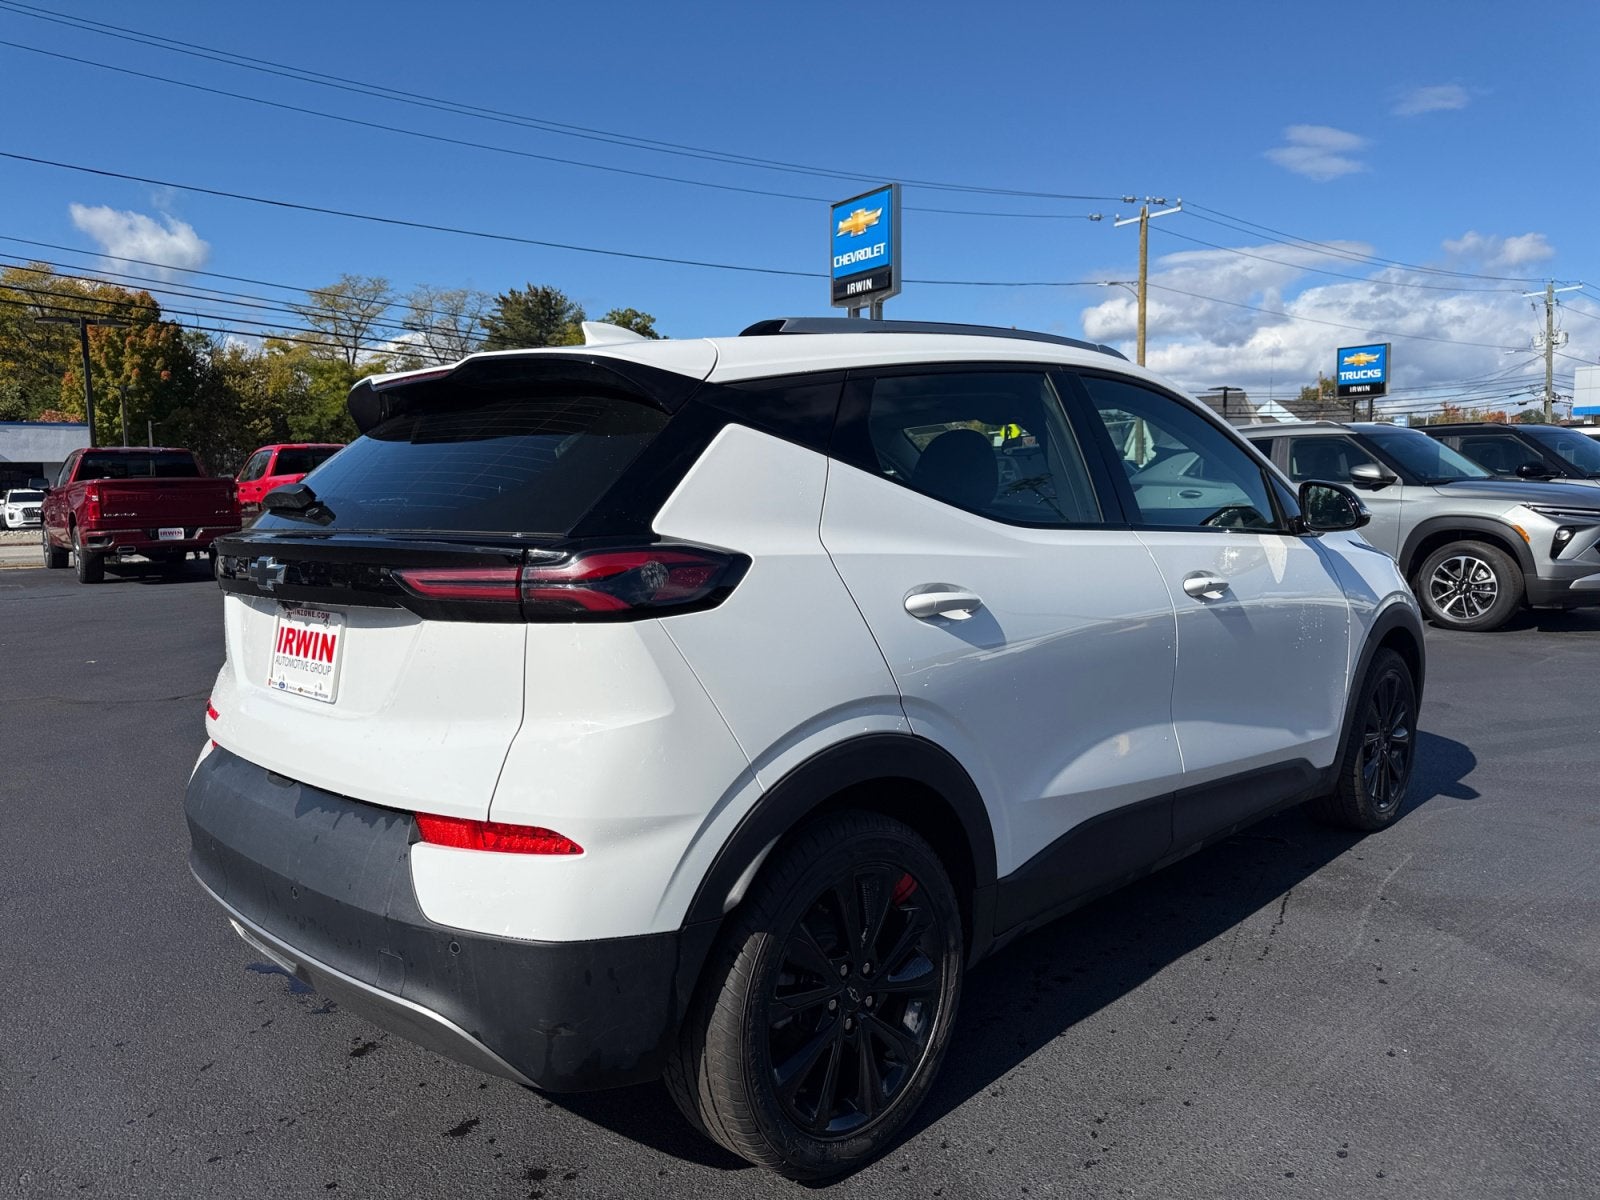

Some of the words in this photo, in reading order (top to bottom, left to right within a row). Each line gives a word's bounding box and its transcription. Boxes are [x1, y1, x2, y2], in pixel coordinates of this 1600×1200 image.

[834, 242, 886, 268] CHEVROLET
[847, 278, 873, 295] IRWIN
[1340, 369, 1381, 380] TRUCKS
[1349, 385, 1370, 393] IRWIN
[276, 626, 336, 663] IRWIN
[275, 655, 309, 671] AUTOMOTIVE
[310, 662, 332, 675] GROUP
